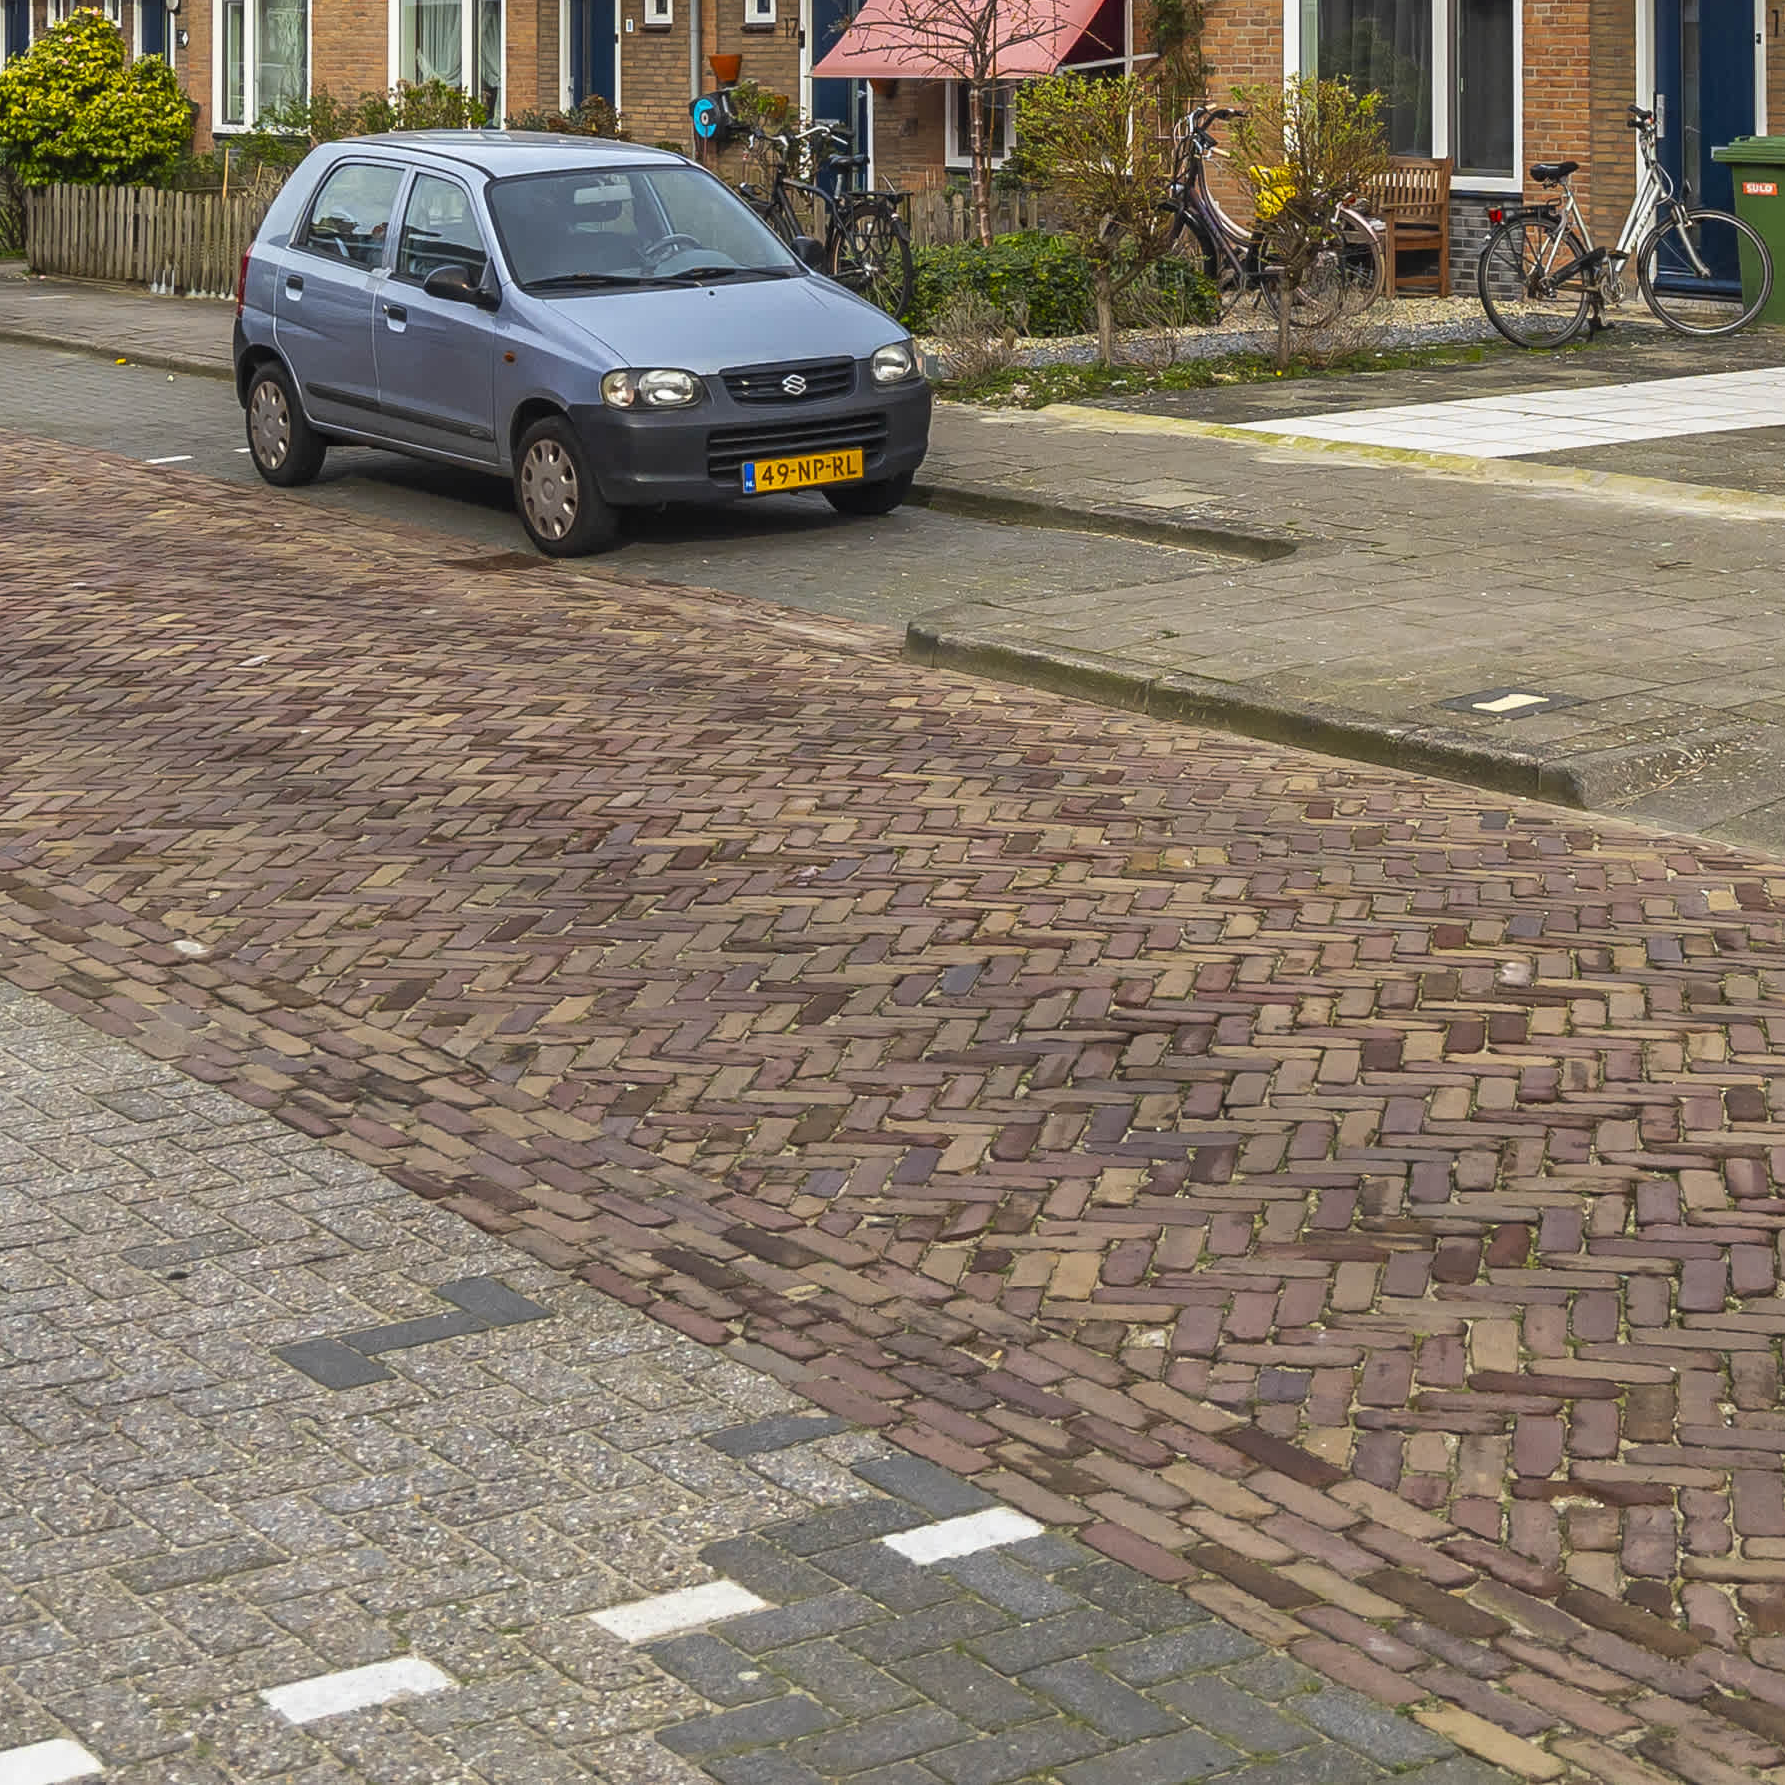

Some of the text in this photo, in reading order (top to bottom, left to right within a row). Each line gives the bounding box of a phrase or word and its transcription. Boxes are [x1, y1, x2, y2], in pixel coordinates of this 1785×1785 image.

[784, 17, 798, 38] 17
[1746, 184, 1773, 192] SULO
[762, 455, 857, 486] 49-NP-RL
